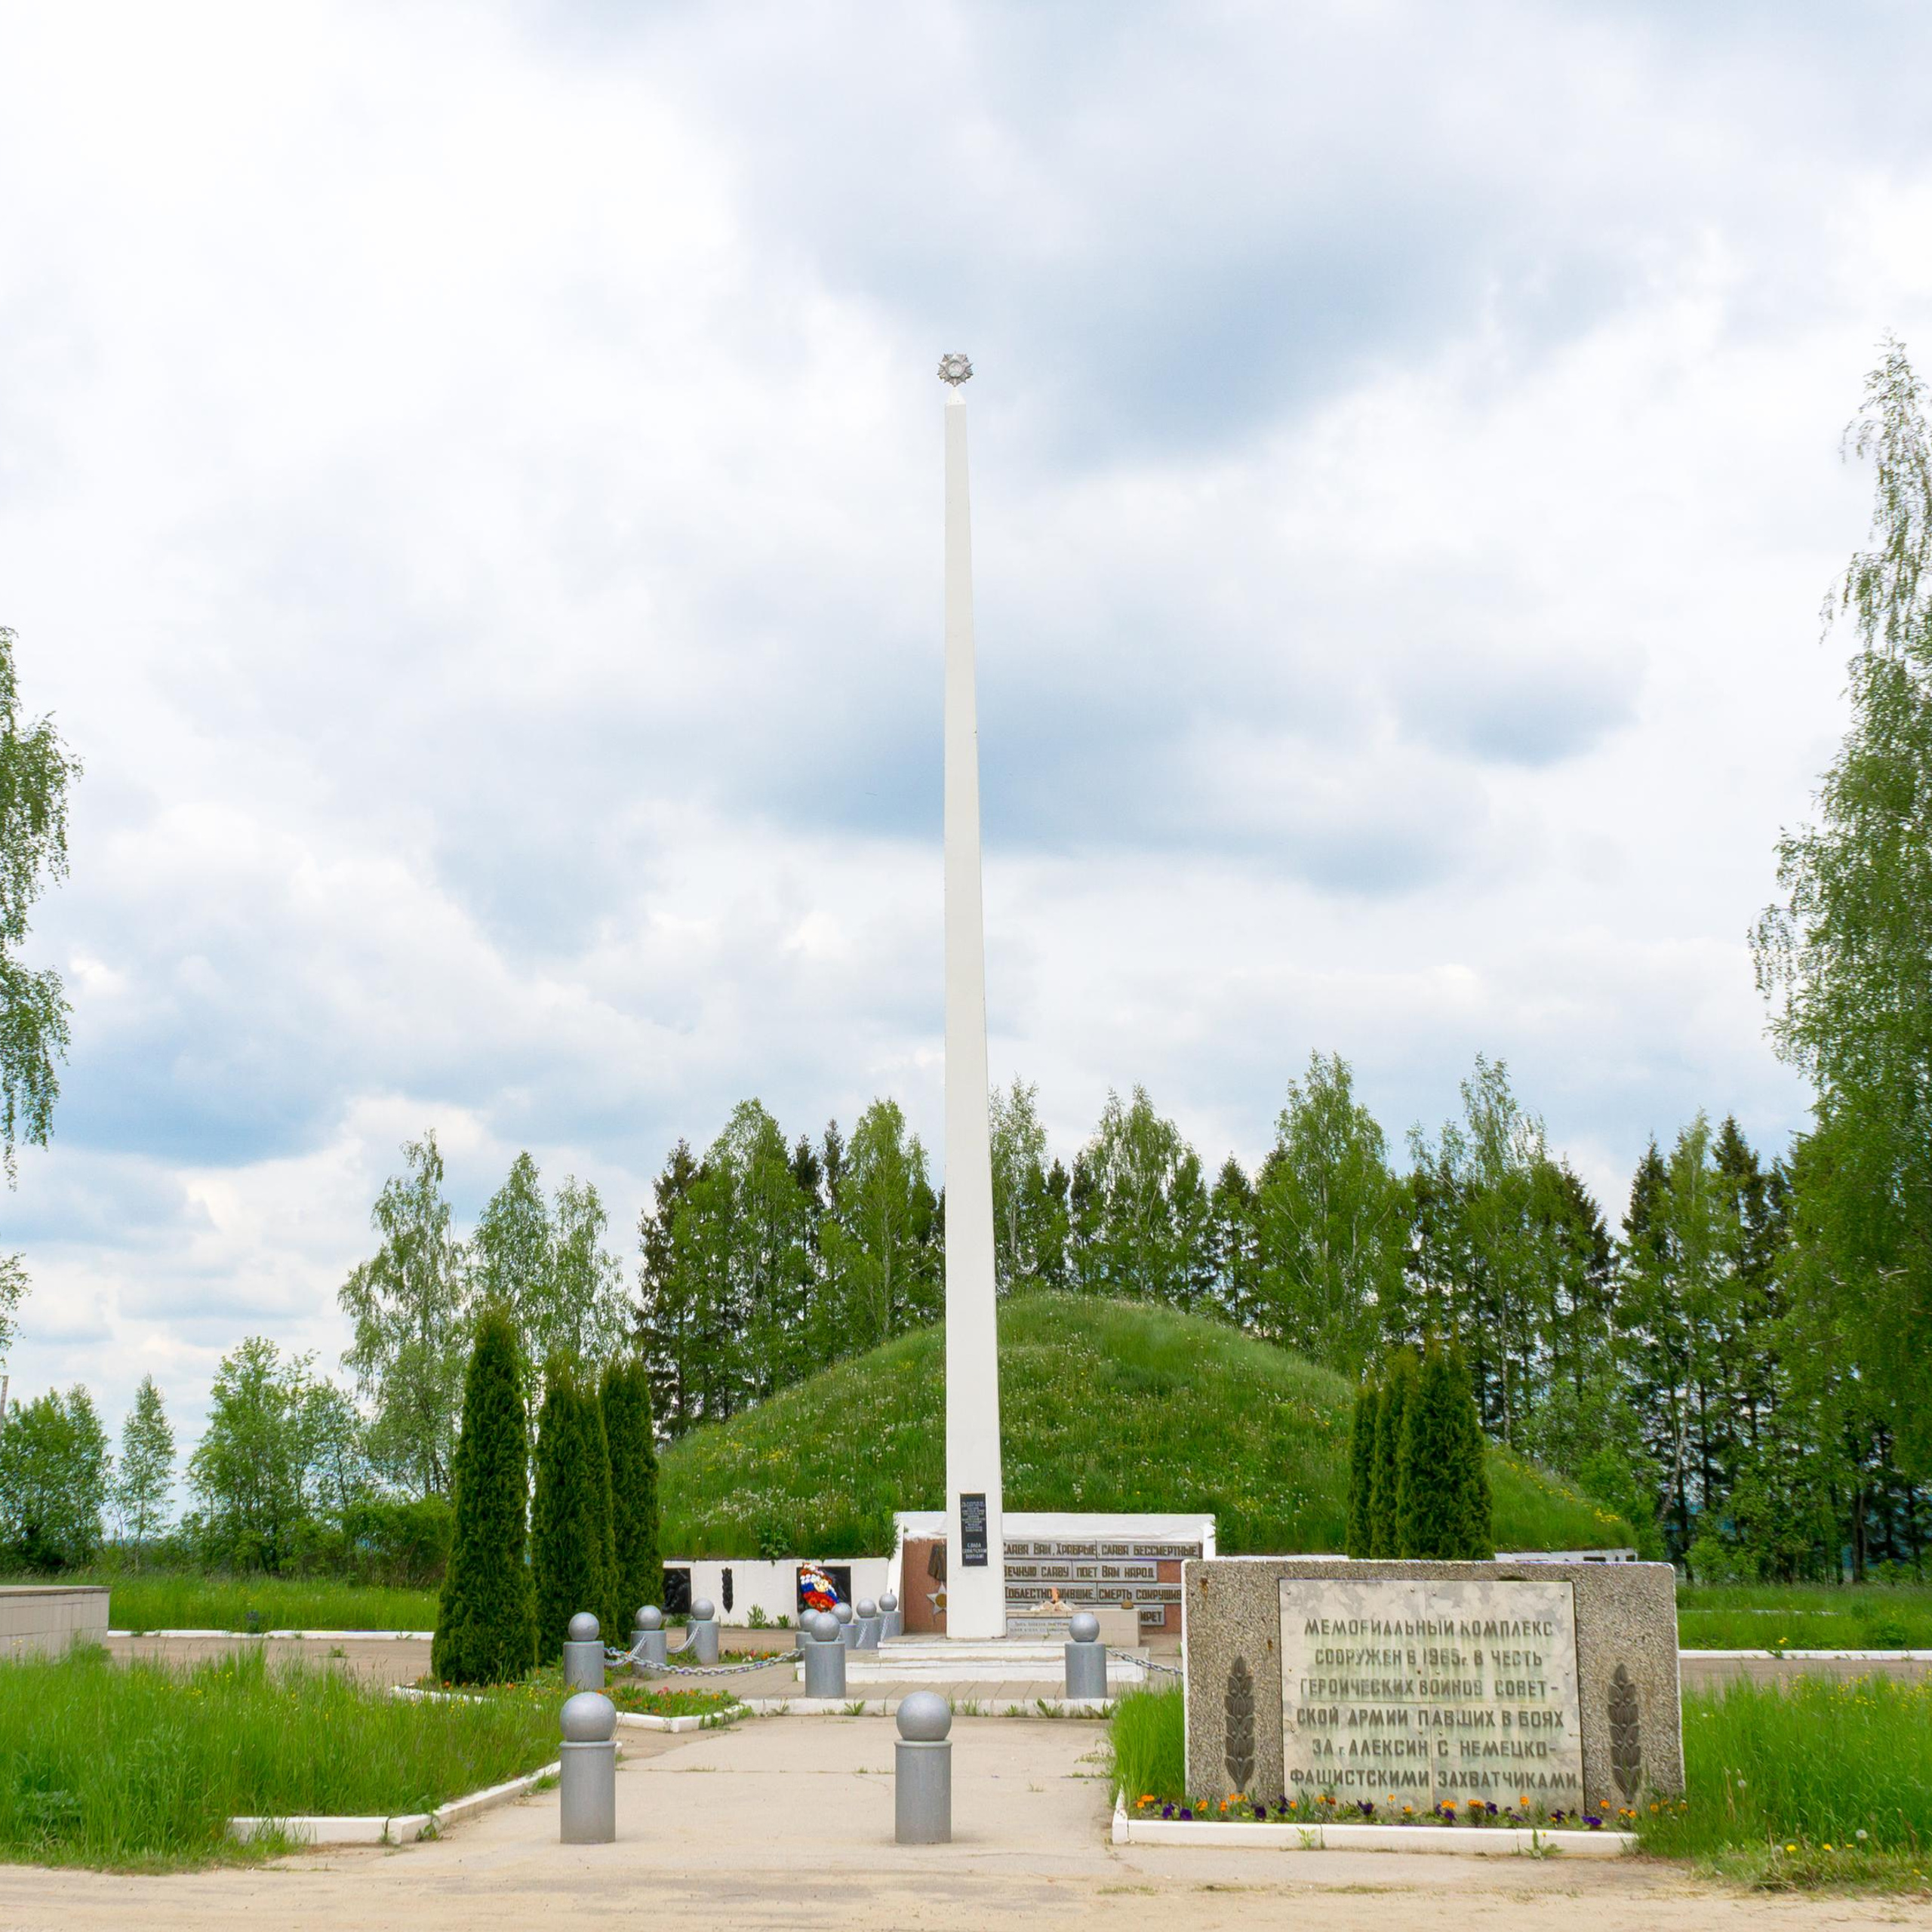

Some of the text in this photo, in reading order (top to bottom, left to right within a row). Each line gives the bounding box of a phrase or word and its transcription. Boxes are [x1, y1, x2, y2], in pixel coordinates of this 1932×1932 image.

[1102, 1544, 1128, 1555] СЛАВА
[1041, 1567, 1069, 1578] СЛАВУ
[1076, 1567, 1097, 1578] ПОЕТ
[1124, 1567, 1154, 1578] НАРОД
[1099, 1589, 1132, 1600] СМЕРТЬ
[1460, 1620, 1553, 1637] КОМПЛЕКС
[1315, 1648, 1401, 1666] СООРУЖЕН
[1407, 1649, 1417, 1665] В
[1474, 1649, 1484, 1666] В
[1491, 1650, 1543, 1666] ЧЕСТЬ
[1300, 1678, 1415, 1697] ГЕРОИЧЕСКИХ
[1419, 1679, 1483, 1697] ВОИНОВ
[1297, 1706, 1564, 1728] СКОЙ АРМИИ ПАВШИХ В БОЯХ
[1312, 1738, 1334, 1755] ЗА
[1349, 1739, 1428, 1757] АЛЕКСИН
[1438, 1740, 1448, 1757] С
[1460, 1740, 1557, 1759] НЕМЕЦКО-
[1290, 1768, 1429, 1787] ФАШИСТСКИМИ
